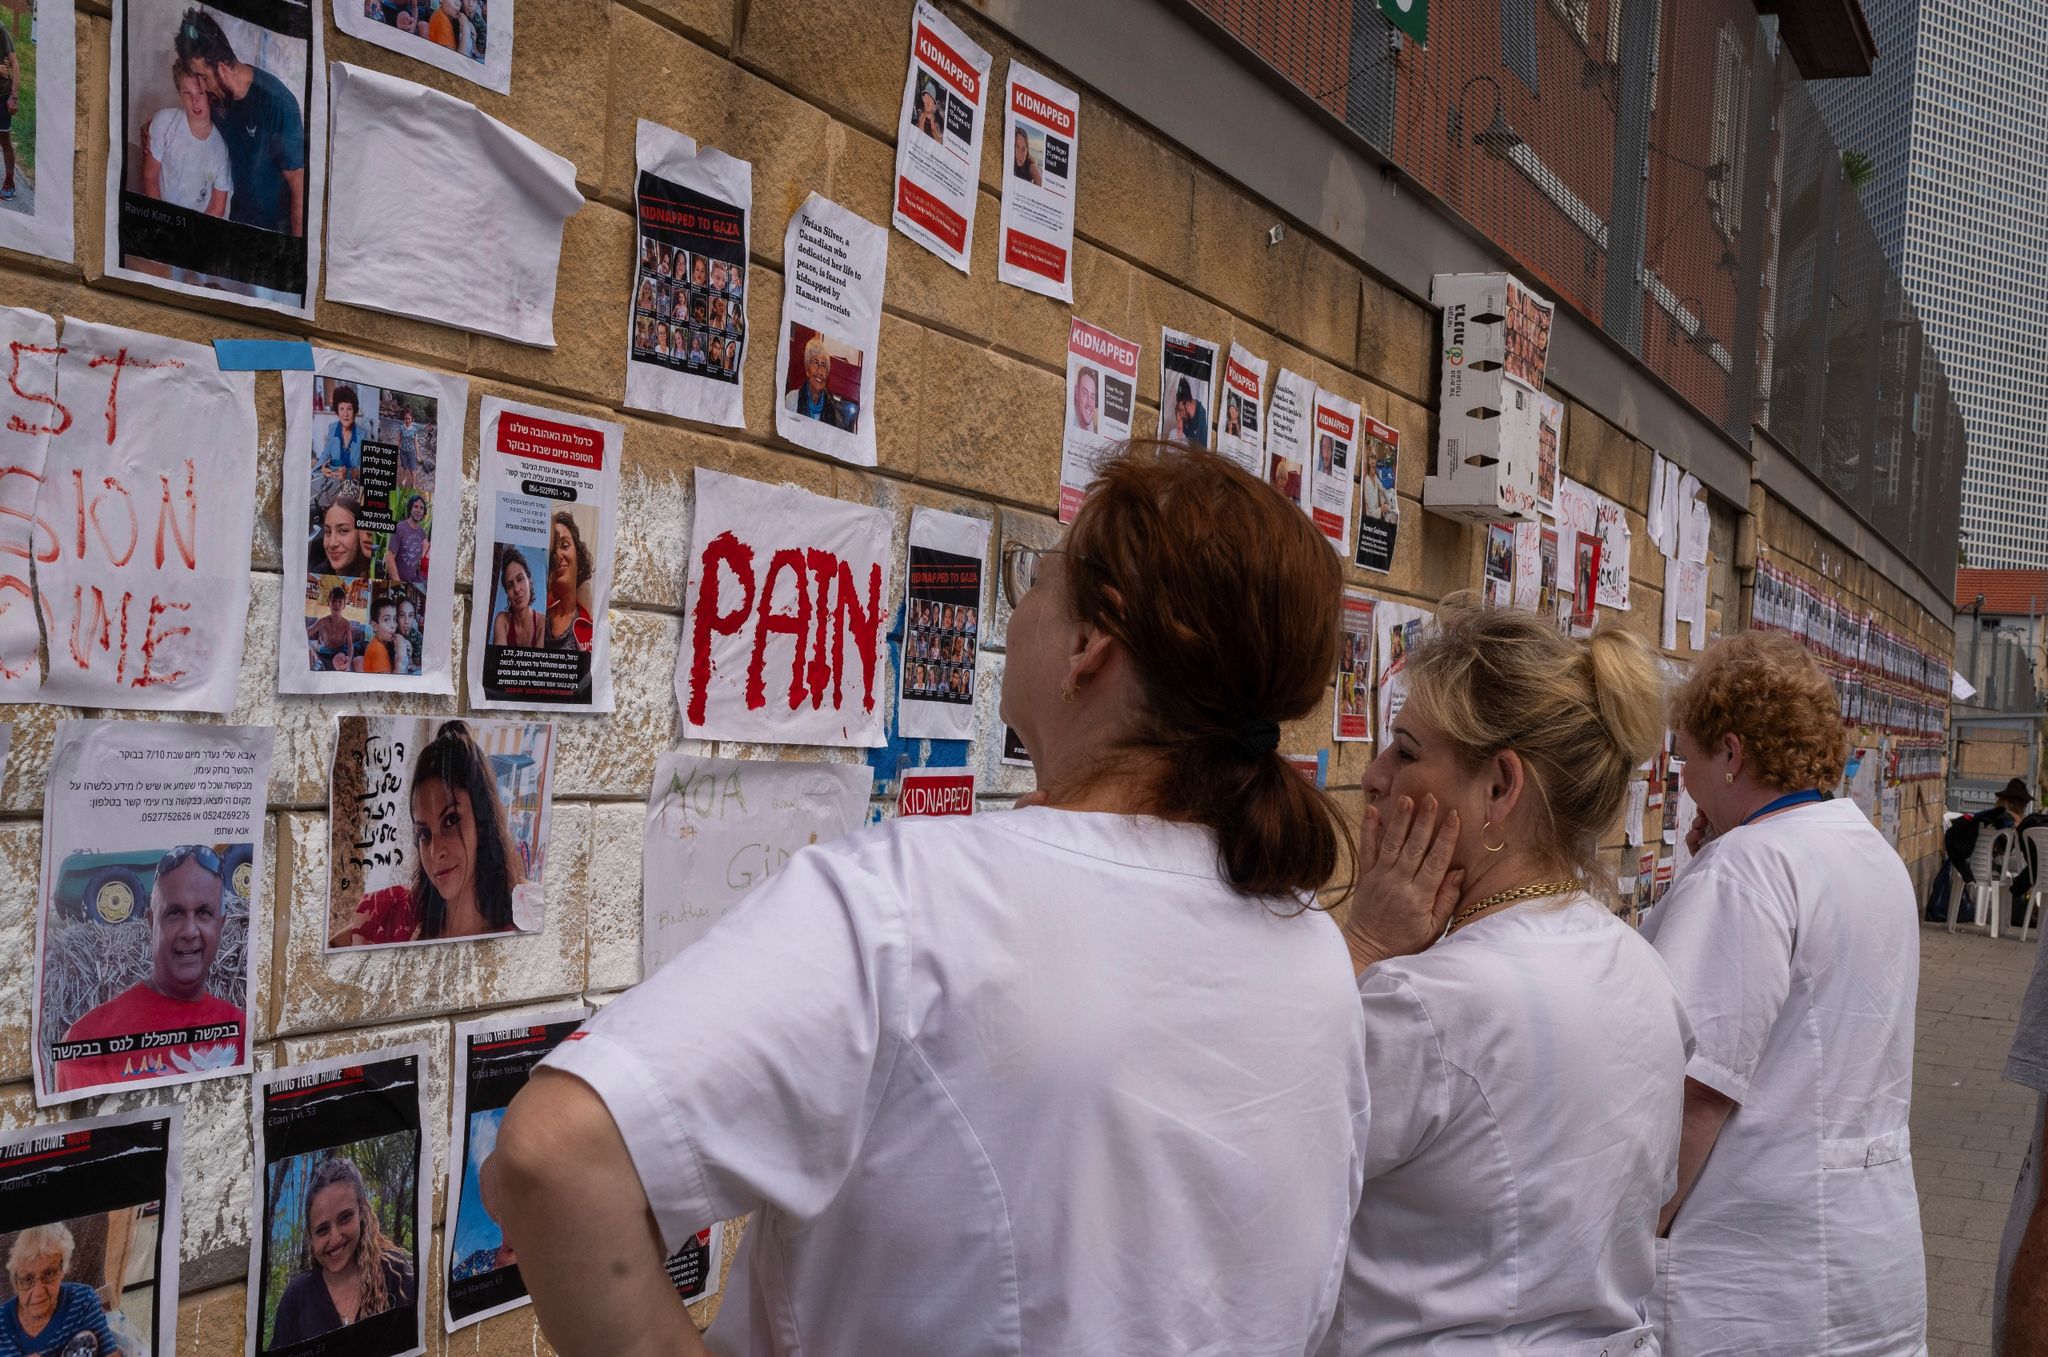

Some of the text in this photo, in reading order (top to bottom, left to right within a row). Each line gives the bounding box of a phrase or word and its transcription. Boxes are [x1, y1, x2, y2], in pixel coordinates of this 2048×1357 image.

[919, 37, 974, 93] KIDNAPPED
[1016, 90, 1070, 128] KIDNAPPED
[125, 202, 149, 218] Ravid
[175, 215, 186, 228] 51
[640, 204, 739, 236] KIDNAPPED TO GAZA
[802, 214, 849, 247] Vivian Silver, a
[799, 229, 847, 259] Canadian who
[796, 259, 847, 288] peace, is feared
[798, 243, 861, 280] dedicated her life to
[796, 270, 840, 300] kidnapped by
[795, 285, 820, 304] Hamas
[821, 297, 850, 318] terrorists
[1453, 304, 1466, 345] גרנות
[1073, 327, 1134, 367] KIDNAPPED
[510, 422, 593, 446] כרמל גת האהובה שלנו
[507, 439, 593, 463] חטופה מיום שבת בבוקר
[364, 478, 388, 486] כרמלה דן
[356, 520, 395, 531] 0547917020
[362, 511, 391, 519] ליצירת קשר
[950, 572, 959, 583] TO
[960, 572, 978, 583] GAZA
[687, 529, 882, 726] PAIN
[116, 750, 257, 761] אבא שלי נעדר מיום שבת 7/10 בבוקר.
[352, 736, 405, 772] דניאלה
[193, 766, 254, 776] הקשר נותק עימו,
[69, 780, 253, 791] מבקשת שכל מי ששמע או שיש לו מידע כלשהו על
[355, 772, 402, 800] שלנו
[653, 765, 748, 825] NOA
[89, 796, 251, 809] מקום הימצאו, בבקשה צרו עימי קשר בטלפון:
[902, 786, 971, 815] KIDNAPPED
[139, 811, 250, 823] 0524269276 או 0527752626.
[213, 826, 249, 836] אנא שתפו
[353, 823, 397, 849] אלינו
[52, 1024, 240, 1061] בבקשה תתפללו לנס בבקשה
[269, 1077, 295, 1095] BRING
[297, 1073, 319, 1089] THEM
[320, 1069, 343, 1084] HOME
[306, 1106, 317, 1117] 53
[4, 1140, 33, 1158] THEM
[34, 1135, 65, 1152] HOME
[36, 1173, 48, 1184] 72
